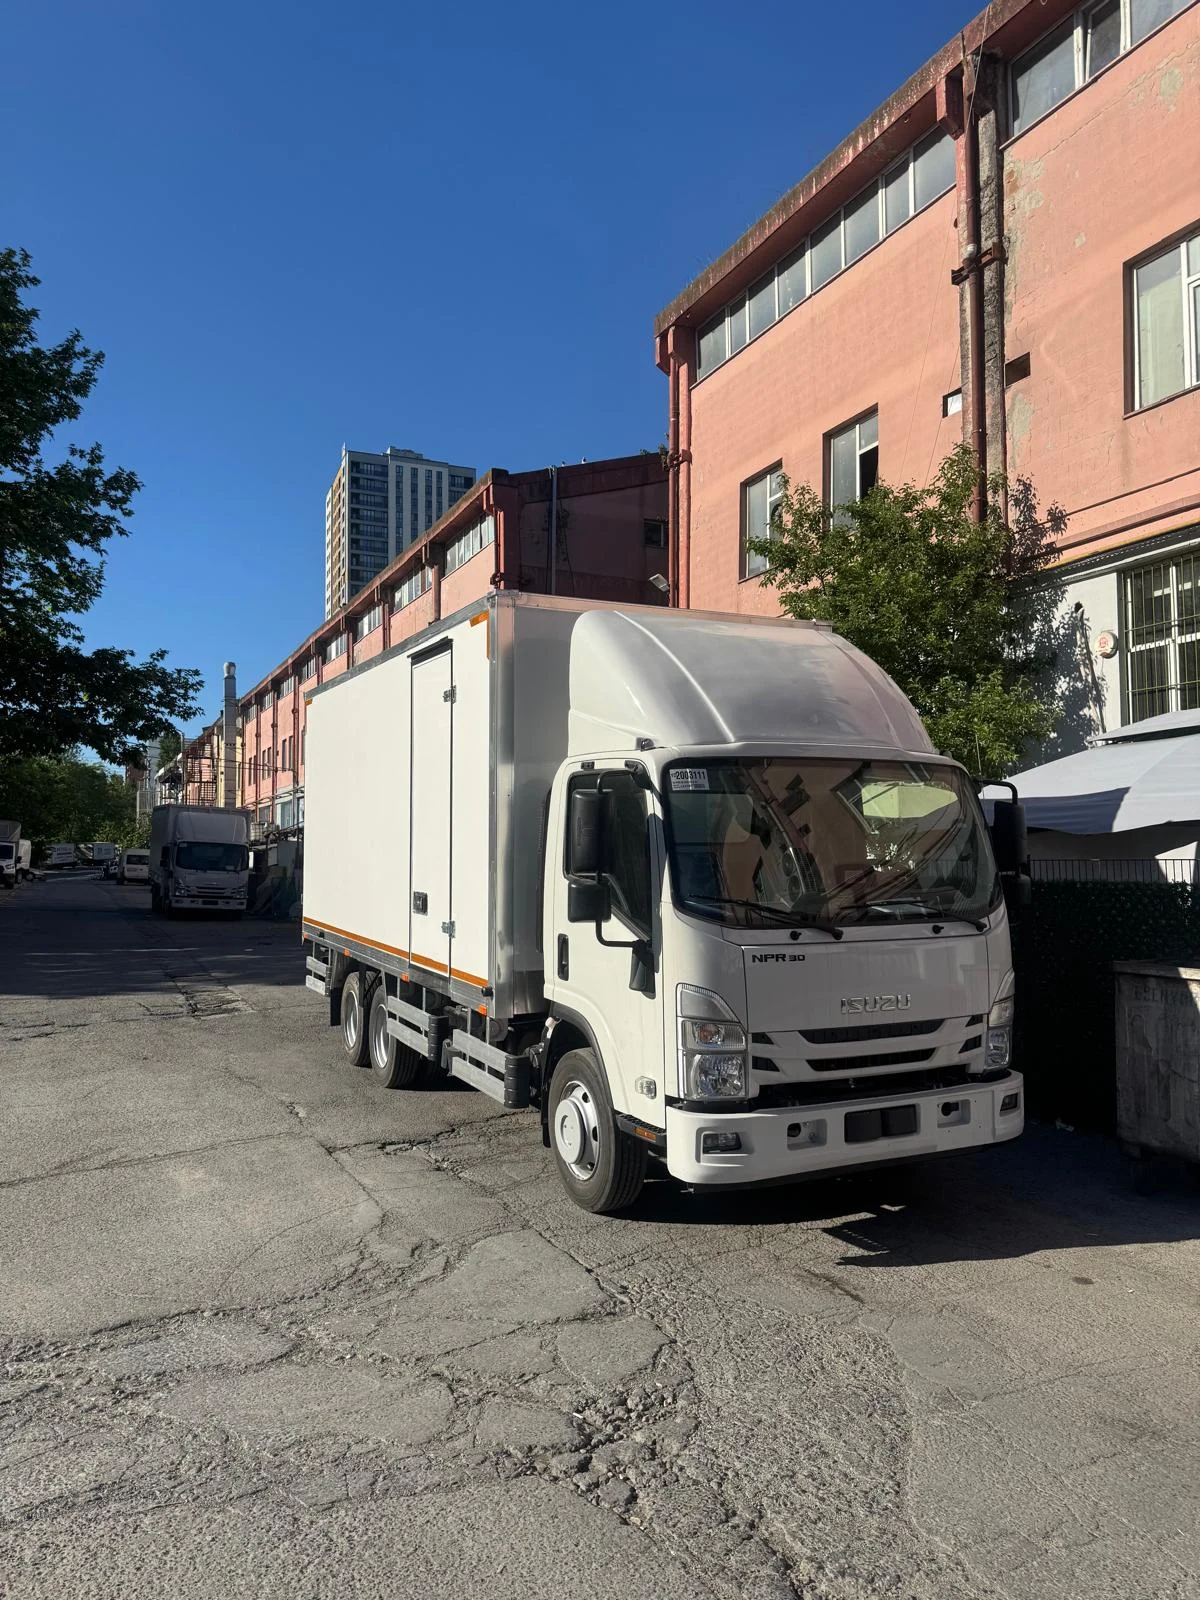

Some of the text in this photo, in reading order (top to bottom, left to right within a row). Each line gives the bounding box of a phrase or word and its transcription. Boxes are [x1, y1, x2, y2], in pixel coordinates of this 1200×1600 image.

[751, 953, 806, 963] NPR 30
[840, 994, 911, 1015] ISUZU
